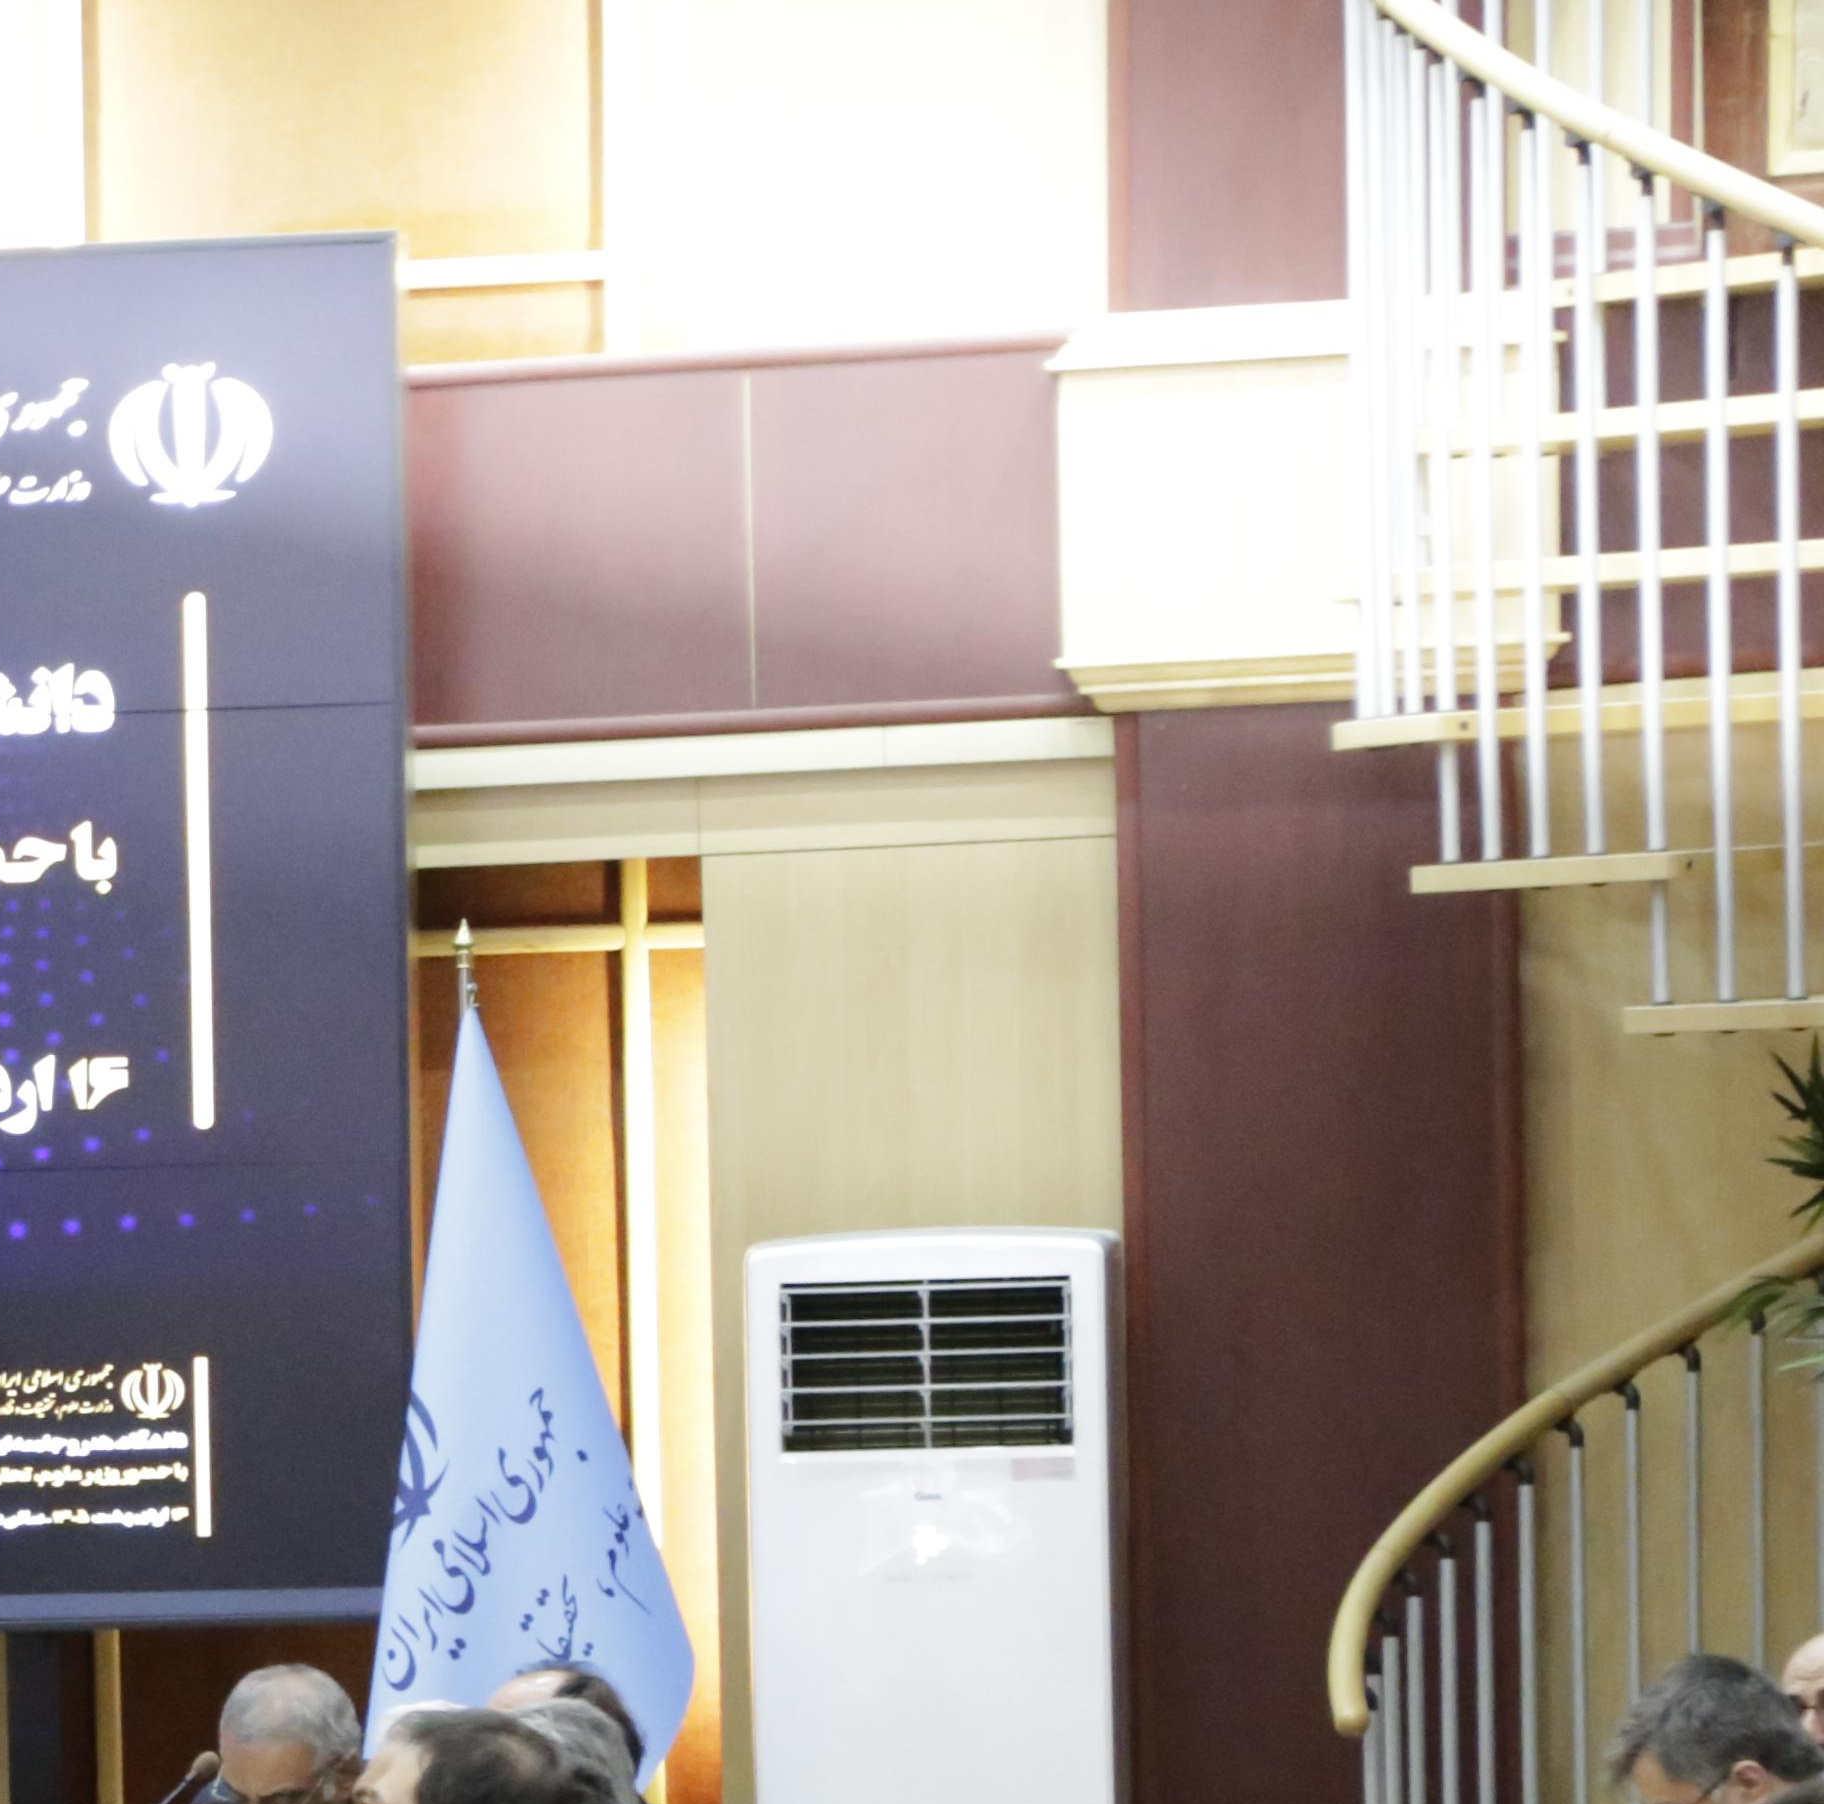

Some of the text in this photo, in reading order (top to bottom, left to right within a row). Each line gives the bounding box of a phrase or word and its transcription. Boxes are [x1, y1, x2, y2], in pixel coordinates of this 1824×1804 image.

[72, 822, 117, 894] با
[69, 1057, 129, 1110] ۱۶
[382, 1387, 588, 1692] جمهوری اسلامی ایران
[516, 1574, 594, 1675] تحقیقا
